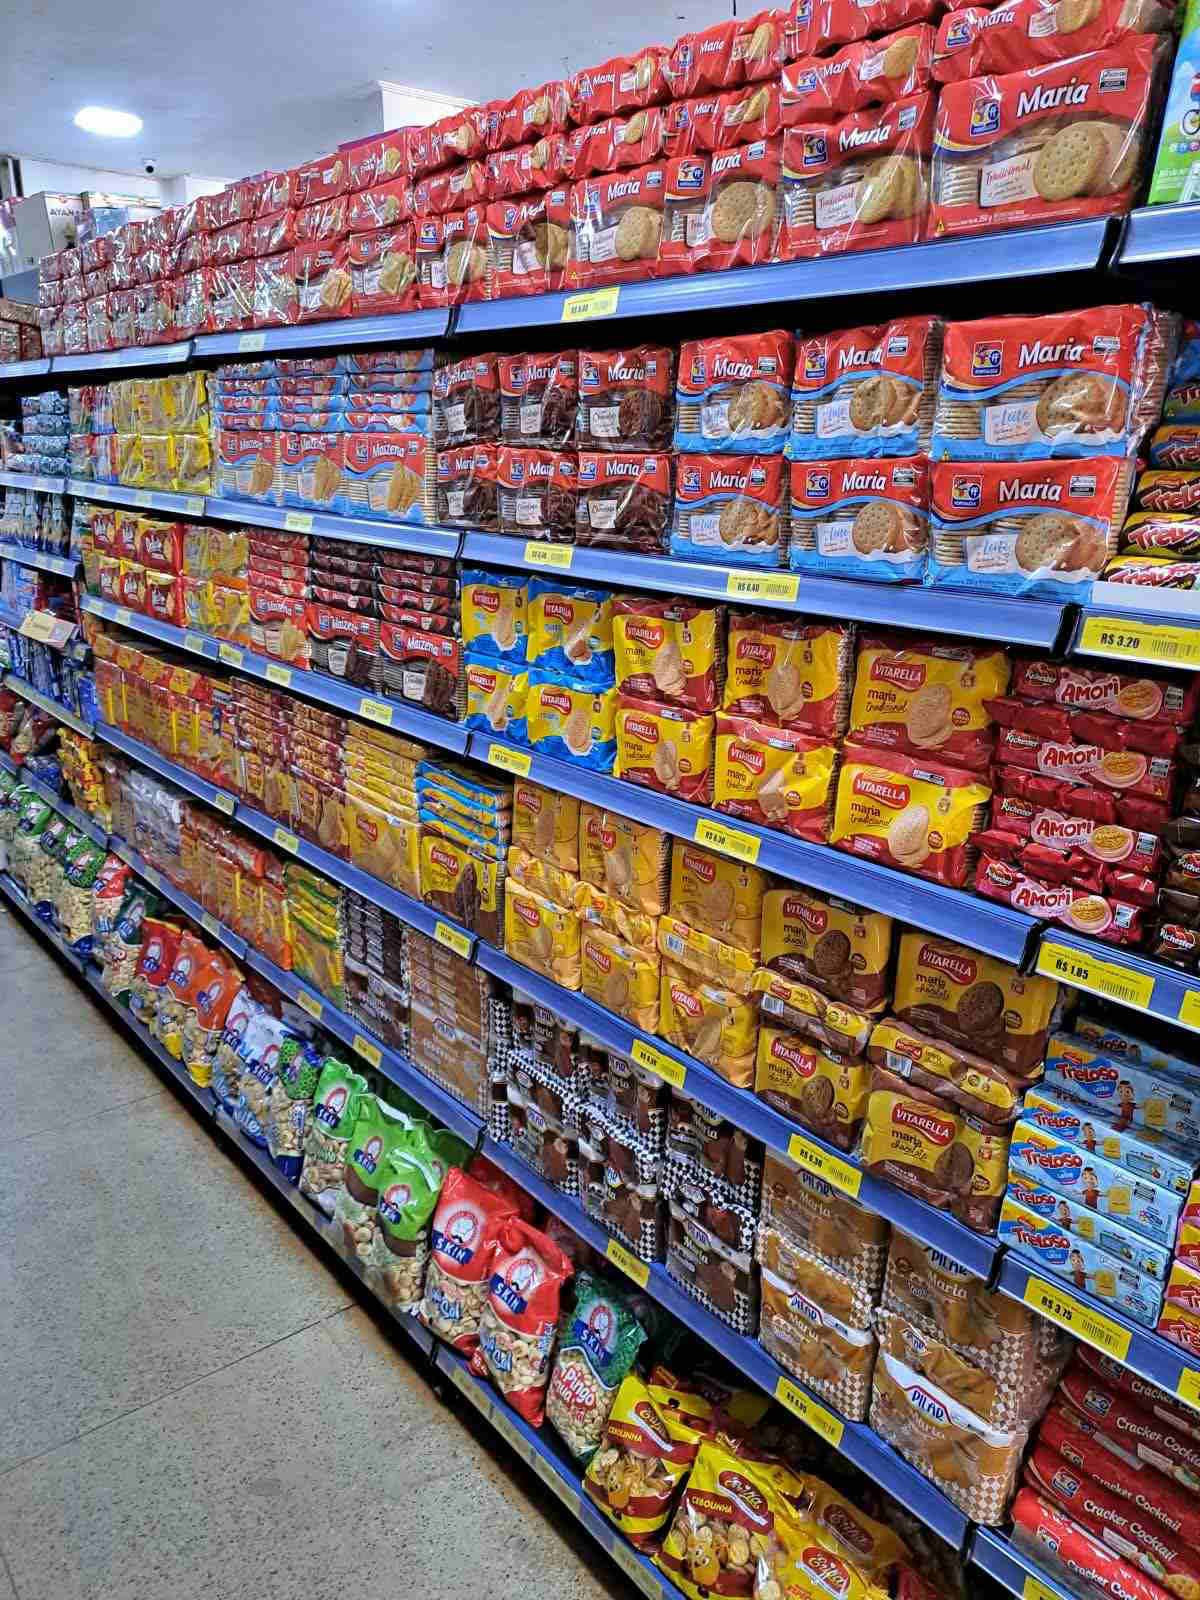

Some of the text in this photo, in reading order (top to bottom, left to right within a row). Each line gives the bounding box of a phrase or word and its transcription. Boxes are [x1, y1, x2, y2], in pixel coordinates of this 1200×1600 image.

[1017, 77, 1090, 118] Maria
[840, 125, 891, 152] Maria
[608, 176, 641, 200] Maria
[1018, 338, 1085, 368] Maria
[608, 363, 645, 381] Maria
[714, 357, 752, 379] Maria
[606, 459, 640, 476] Maria
[709, 471, 747, 488] Maria
[842, 470, 887, 491] Maria
[1000, 477, 1061, 502] Maria
[1101, 632, 1140, 649] R$ 3.20
[874, 664, 922, 683] VITARELLA
[867, 689, 897, 702] maria
[730, 750, 763, 767] VITARELLA
[855, 780, 906, 801] VITARELLA
[851, 802, 881, 816] maria
[786, 902, 824, 928] VITARELLA
[921, 949, 974, 977] VITARELLA
[1056, 959, 1067, 972] R$
[916, 973, 946, 989] maria
[773, 1040, 813, 1072] VITARELLA
[1056, 1063, 1119, 1082] Treloso
[895, 1107, 951, 1141] VITARELLA
[1033, 1110, 1081, 1129] Treloso
[891, 1129, 922, 1150] maria
[1021, 1149, 1082, 1169] Treloso
[1013, 1187, 1056, 1205] Treloso
[1012, 1226, 1071, 1248] Treloso
[435, 1238, 466, 1262] SKIN
[495, 1282, 521, 1312] SKIN
[929, 1272, 968, 1298] Maria
[1040, 1297, 1073, 1321] R$ 3.75
[580, 1330, 606, 1360] SKIN
[563, 1366, 594, 1406] Pingo
[911, 1390, 944, 1421] PILAR
[1116, 1416, 1163, 1441] Cracker
[1135, 1494, 1182, 1532] Cocktail
[1083, 1500, 1178, 1562] Cracker Cocktail
[1067, 1559, 1109, 1585] Cracker
